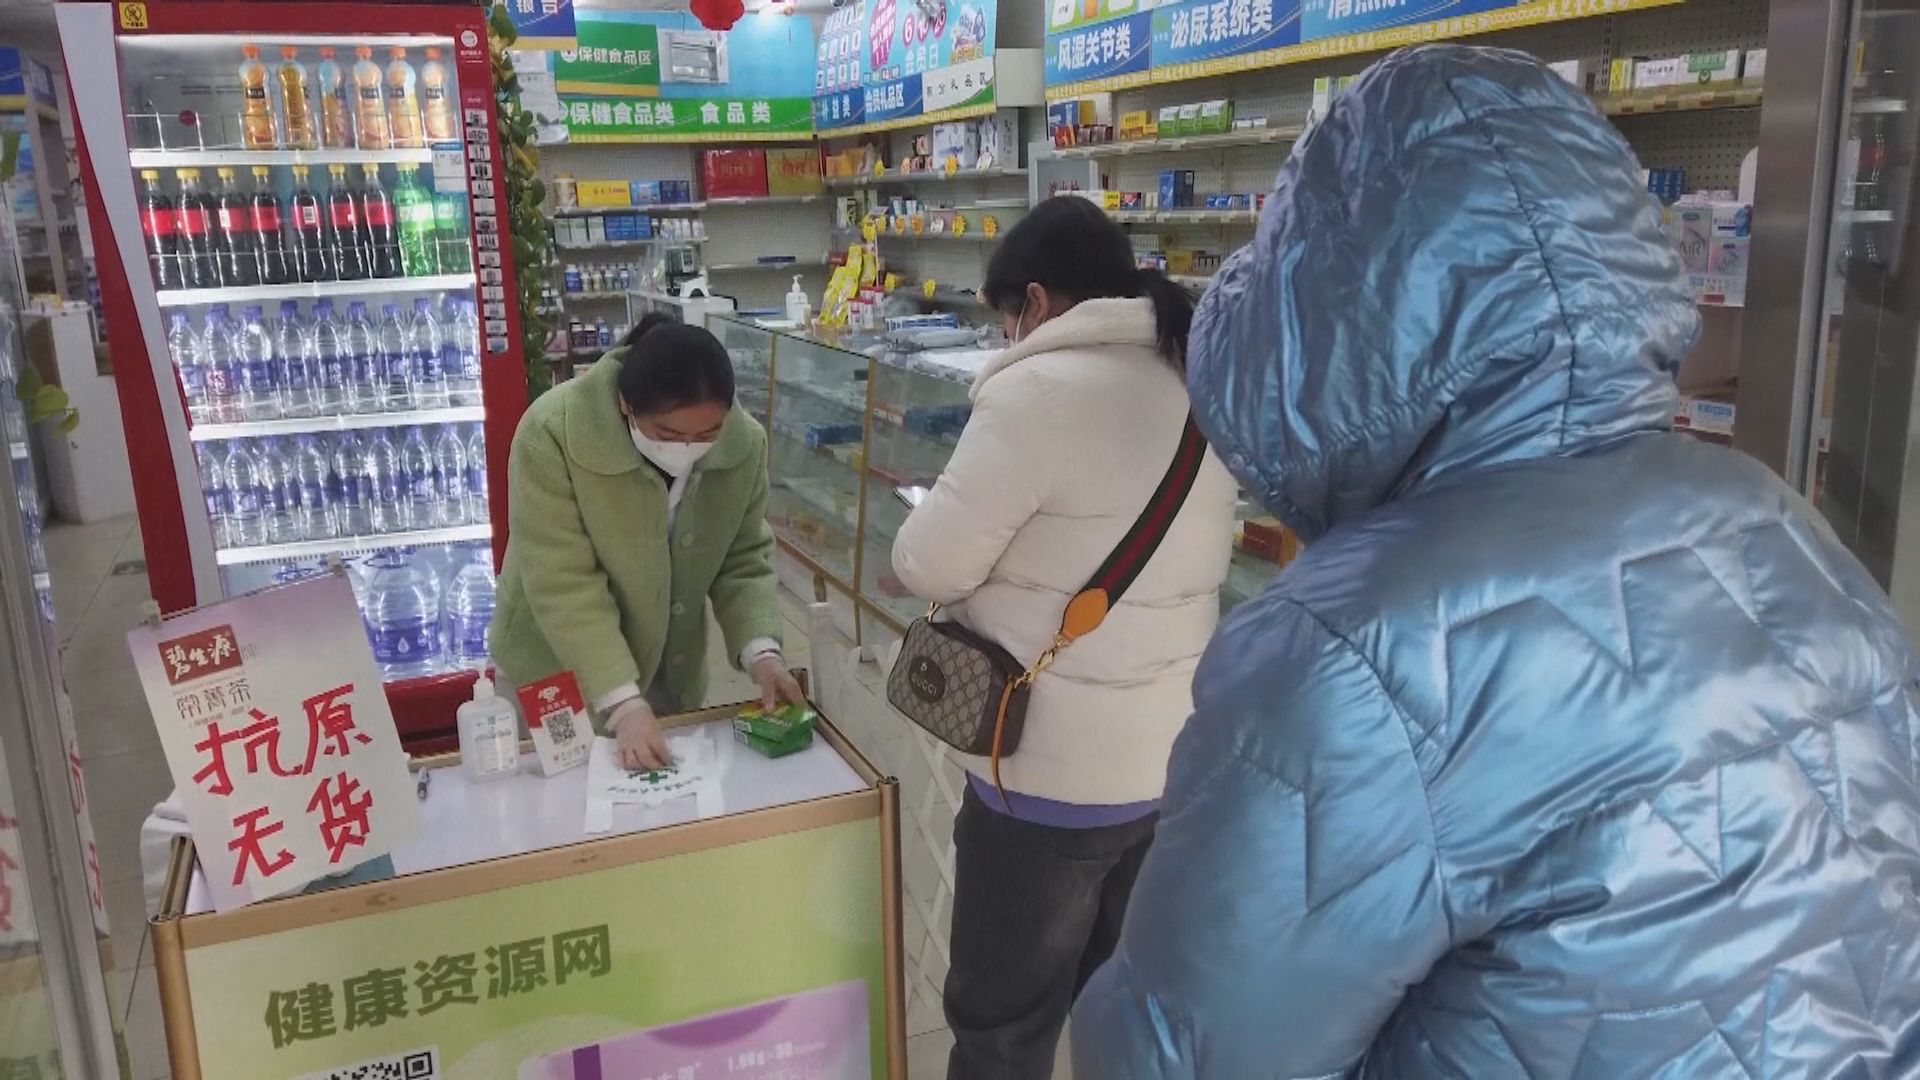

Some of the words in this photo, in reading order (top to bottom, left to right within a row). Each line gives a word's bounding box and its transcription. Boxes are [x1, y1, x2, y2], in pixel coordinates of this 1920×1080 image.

[904, 18, 913, 44] 6
[1058, 22, 1130, 71] 风湿关节类
[1170, 0, 1273, 48] 泌尿系统类
[578, 47, 652, 65] 保健食品区
[570, 101, 675, 126] 保健食品类
[700, 101, 771, 124] 食品类
[865, 83, 904, 113] 会员礼品区
[193, 683, 372, 797] 抗原
[227, 772, 373, 886] 无货
[264, 924, 612, 1049] 健康资源网
